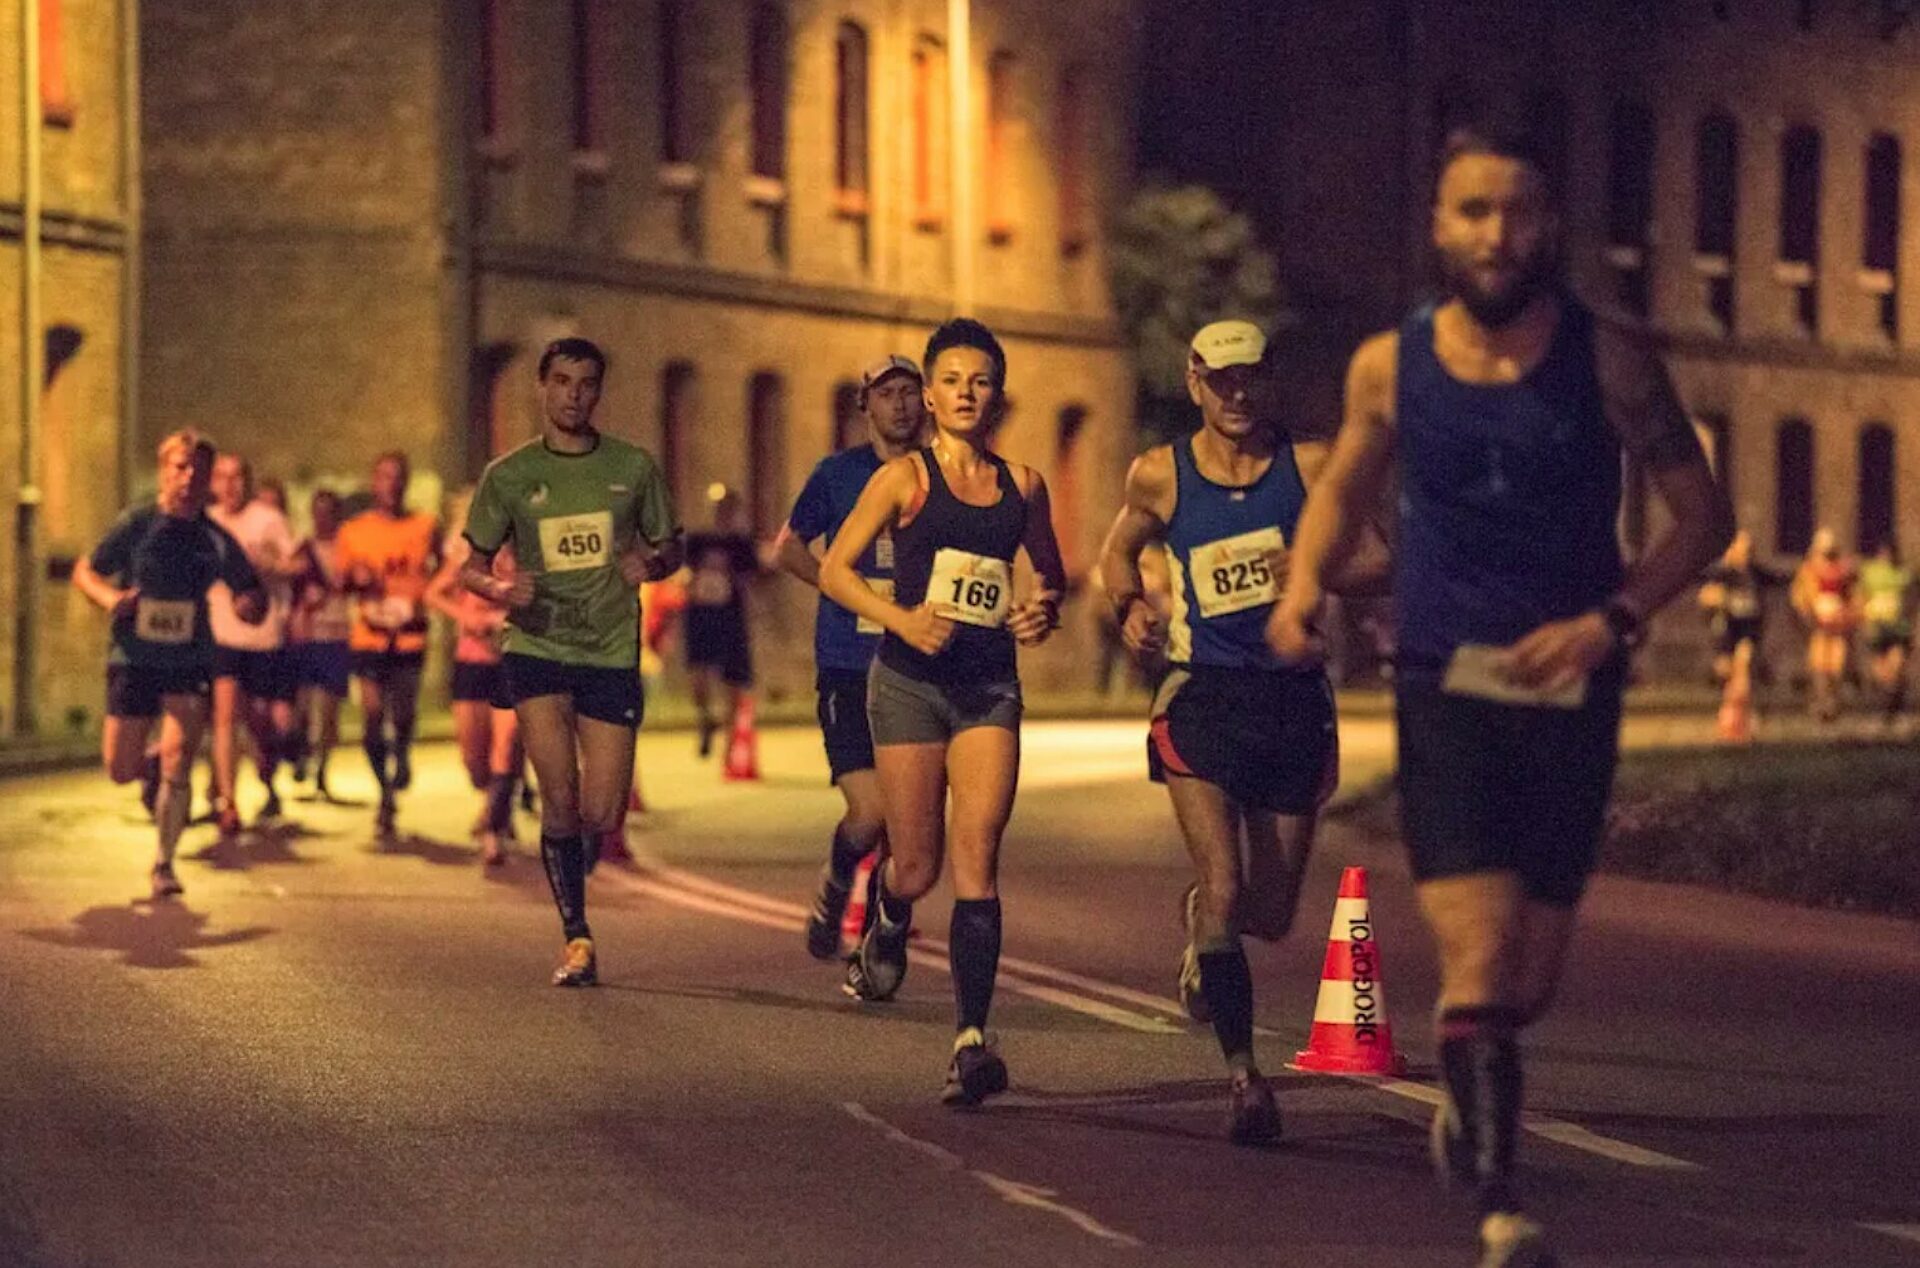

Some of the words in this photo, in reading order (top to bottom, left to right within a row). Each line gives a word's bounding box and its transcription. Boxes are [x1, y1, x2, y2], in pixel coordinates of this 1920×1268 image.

[558, 533, 602, 556] 450
[952, 577, 1000, 610] 169
[1213, 558, 1270, 595] 825
[1348, 911, 1377, 1042] DROGOPOL
